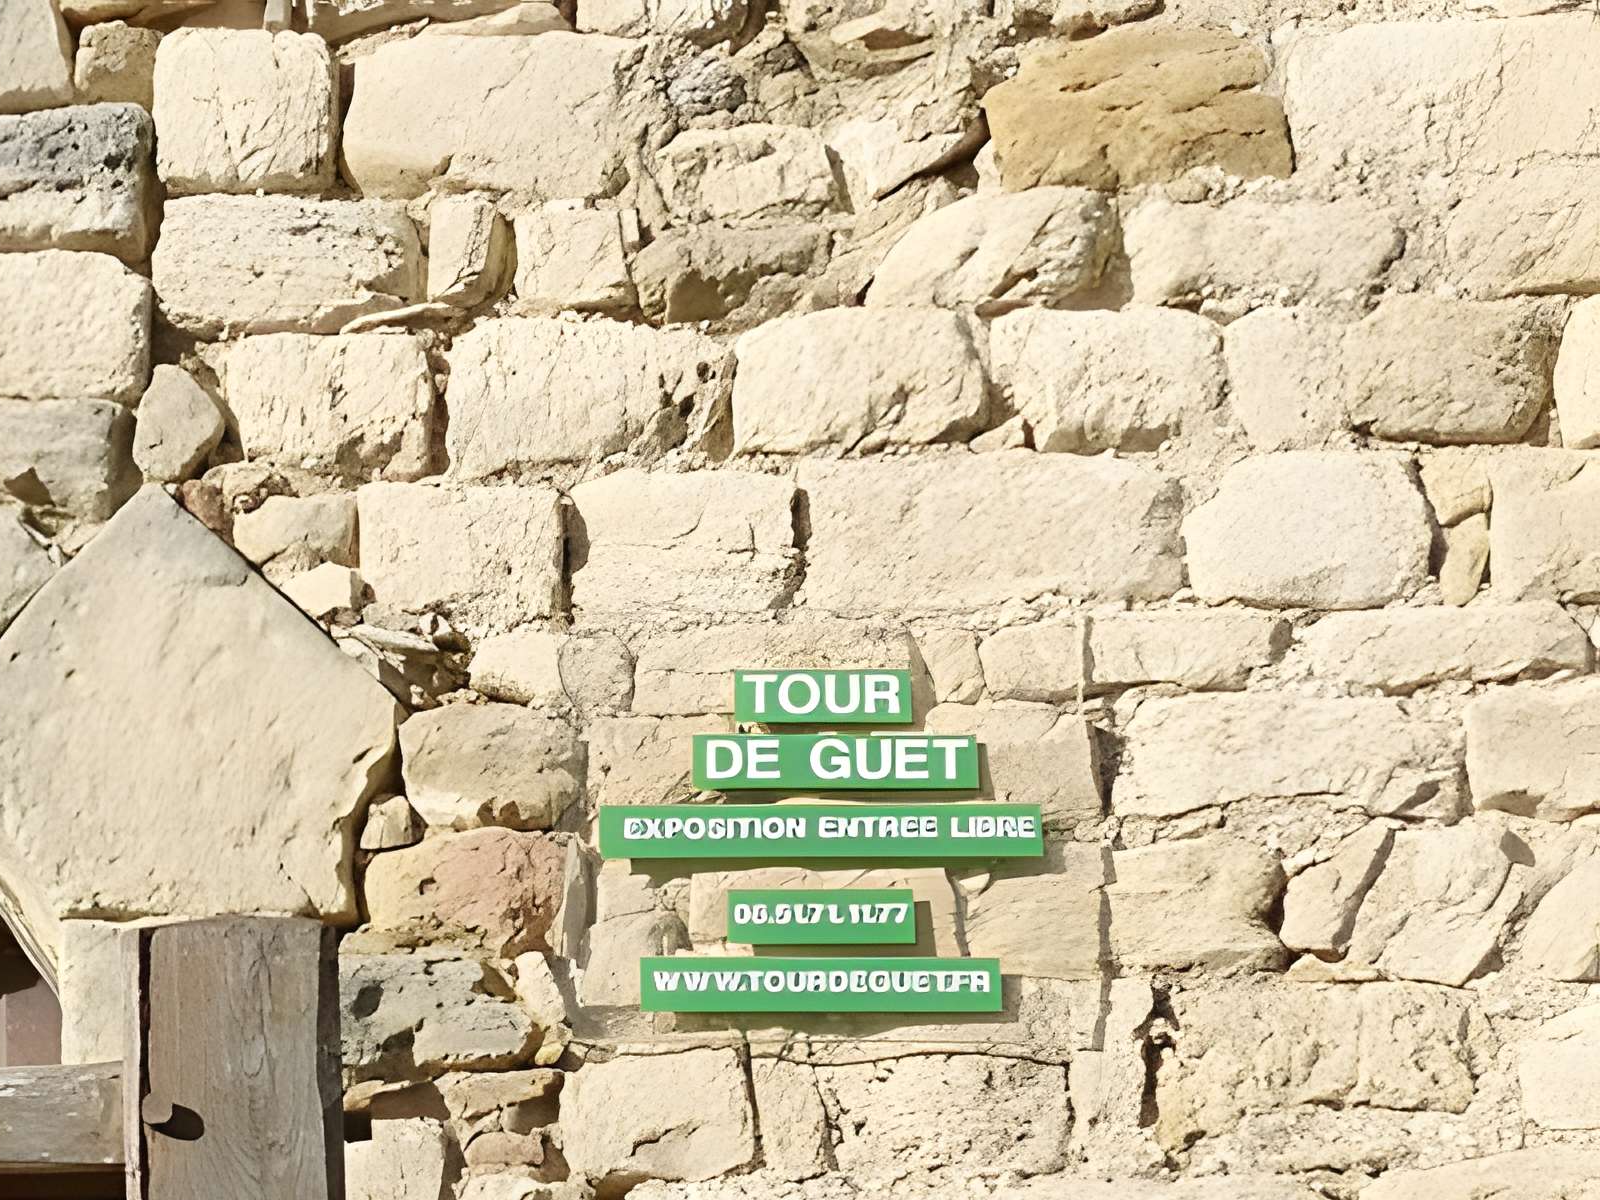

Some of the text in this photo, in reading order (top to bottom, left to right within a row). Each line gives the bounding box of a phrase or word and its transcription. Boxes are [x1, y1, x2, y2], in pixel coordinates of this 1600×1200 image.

[742, 673, 901, 715] TOUR
[705, 738, 970, 781] DE GUET
[622, 817, 807, 840] EXPOSITION
[951, 815, 1037, 838] LIBRE
